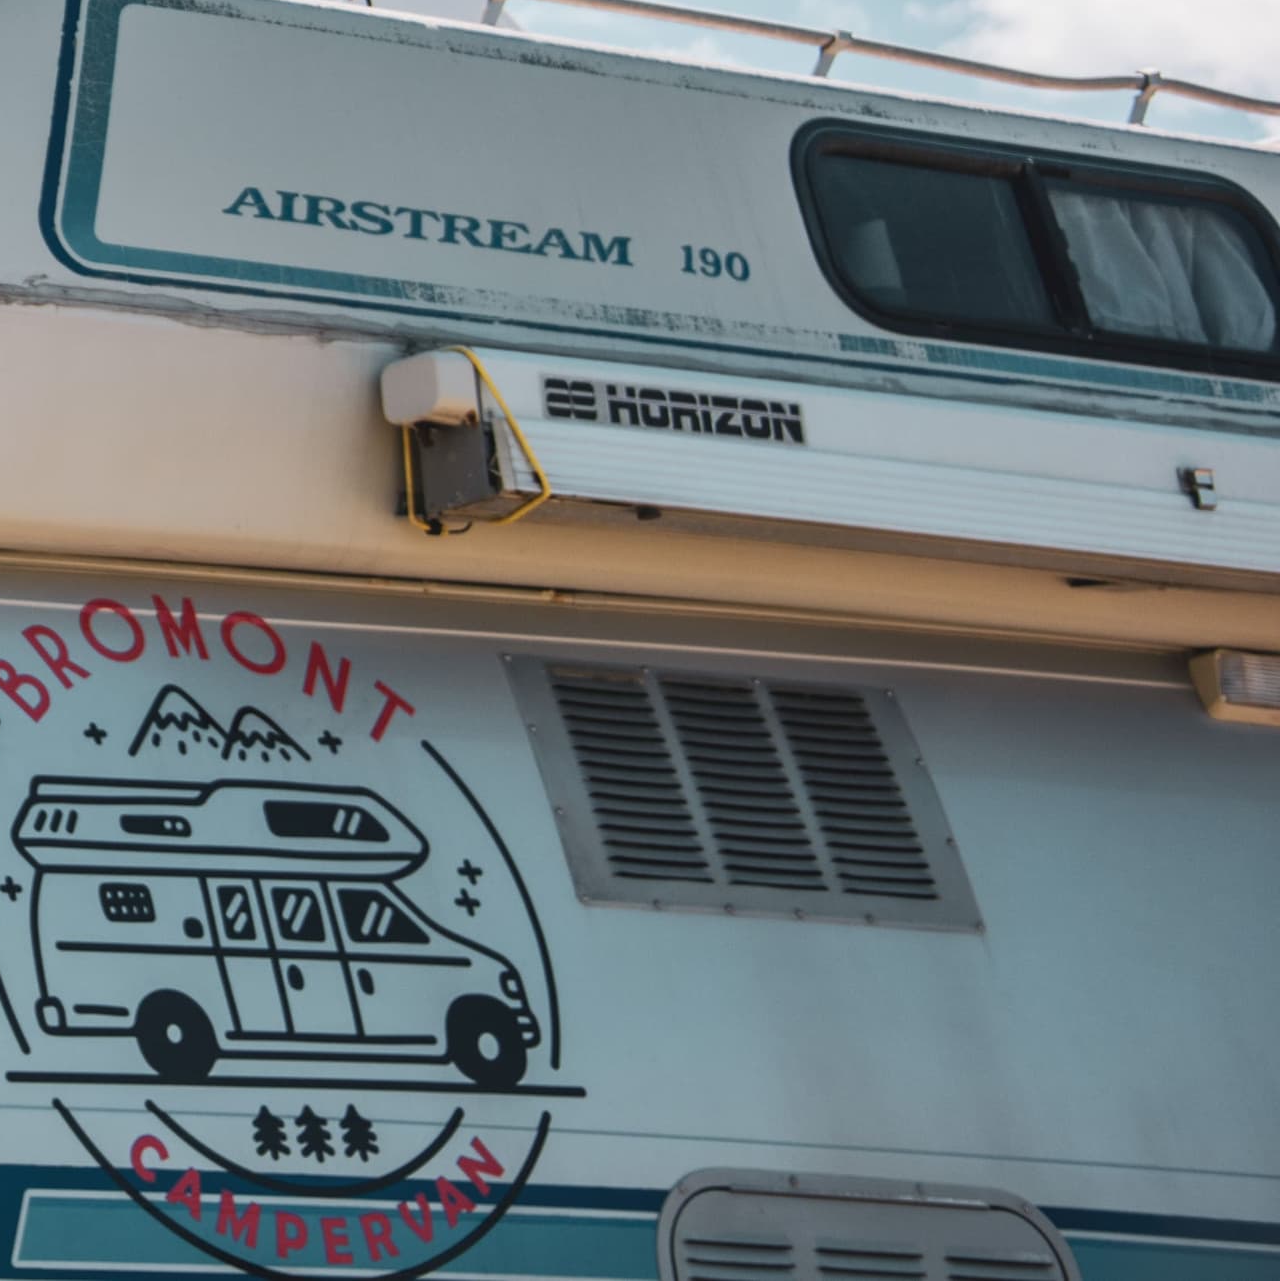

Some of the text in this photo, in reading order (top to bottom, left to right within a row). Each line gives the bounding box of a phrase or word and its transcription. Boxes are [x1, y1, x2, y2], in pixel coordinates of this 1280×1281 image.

[222, 186, 751, 282] AIRSTREAM 190
[605, 383, 805, 444] HORIZON
[130, 1134, 505, 1265] CAMPERVAN
